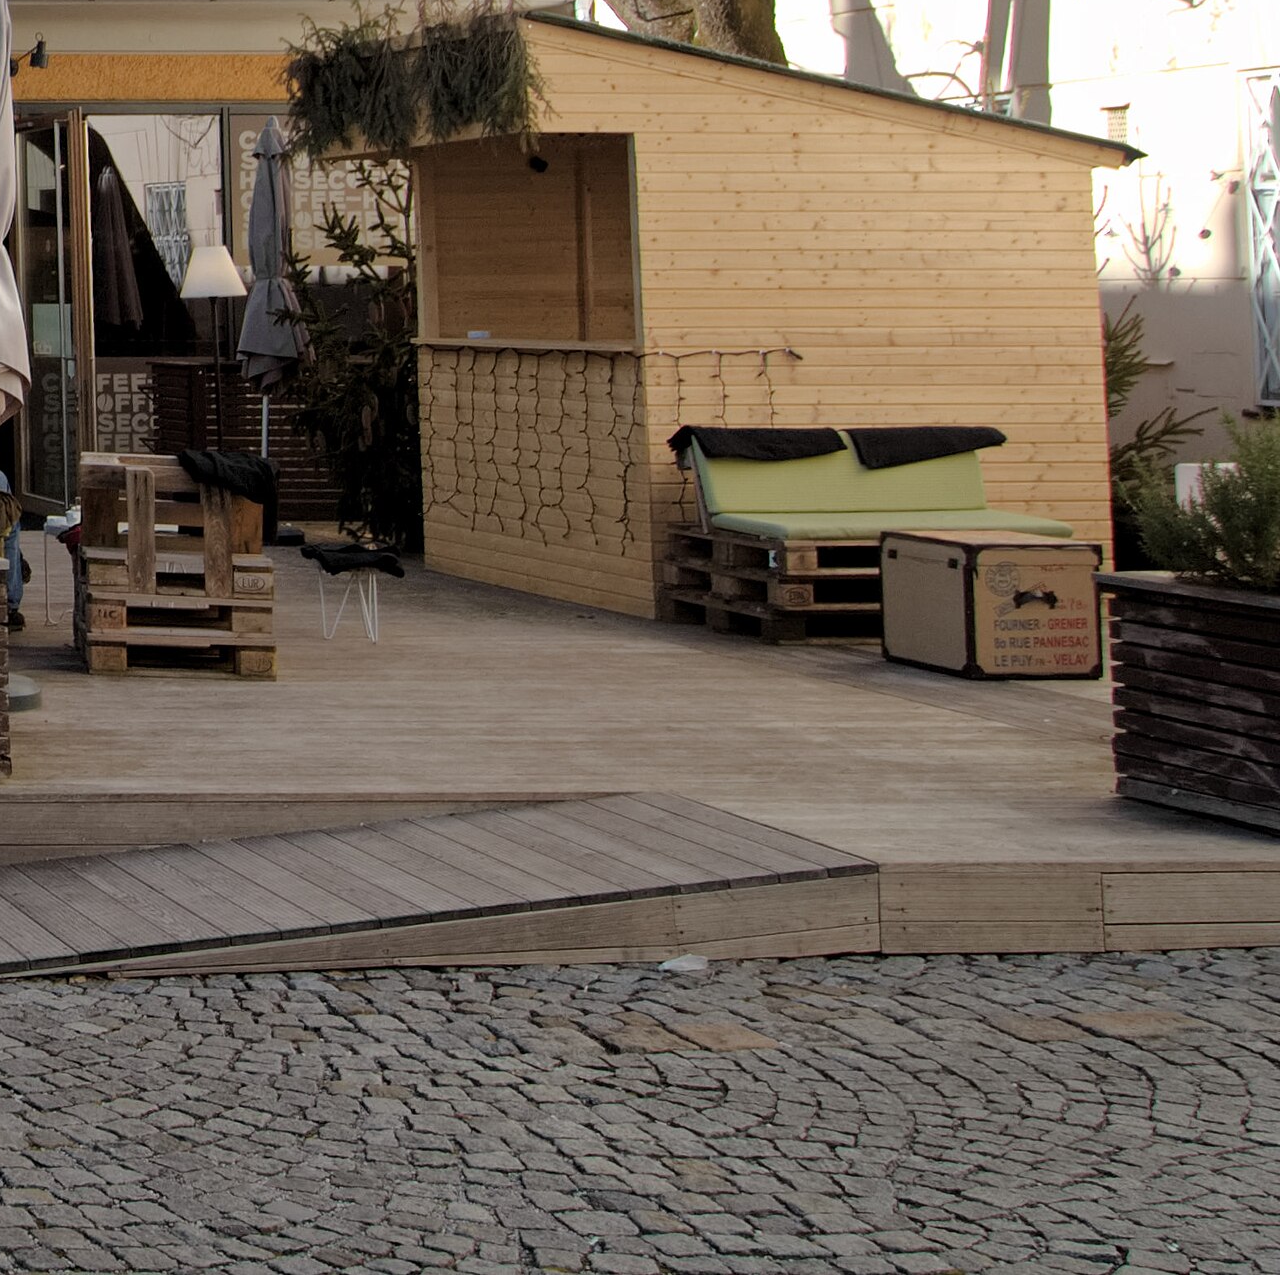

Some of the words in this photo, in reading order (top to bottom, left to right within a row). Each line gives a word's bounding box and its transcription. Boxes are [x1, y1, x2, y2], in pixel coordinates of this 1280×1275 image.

[1048, 618, 1088, 630] GRENIER
[1009, 636, 1031, 649] RUE
[1033, 636, 1089, 648] PANNESAC
[994, 655, 1008, 667] LE
[1010, 655, 1033, 667] PUY
[1054, 654, 1089, 666] VELAY
